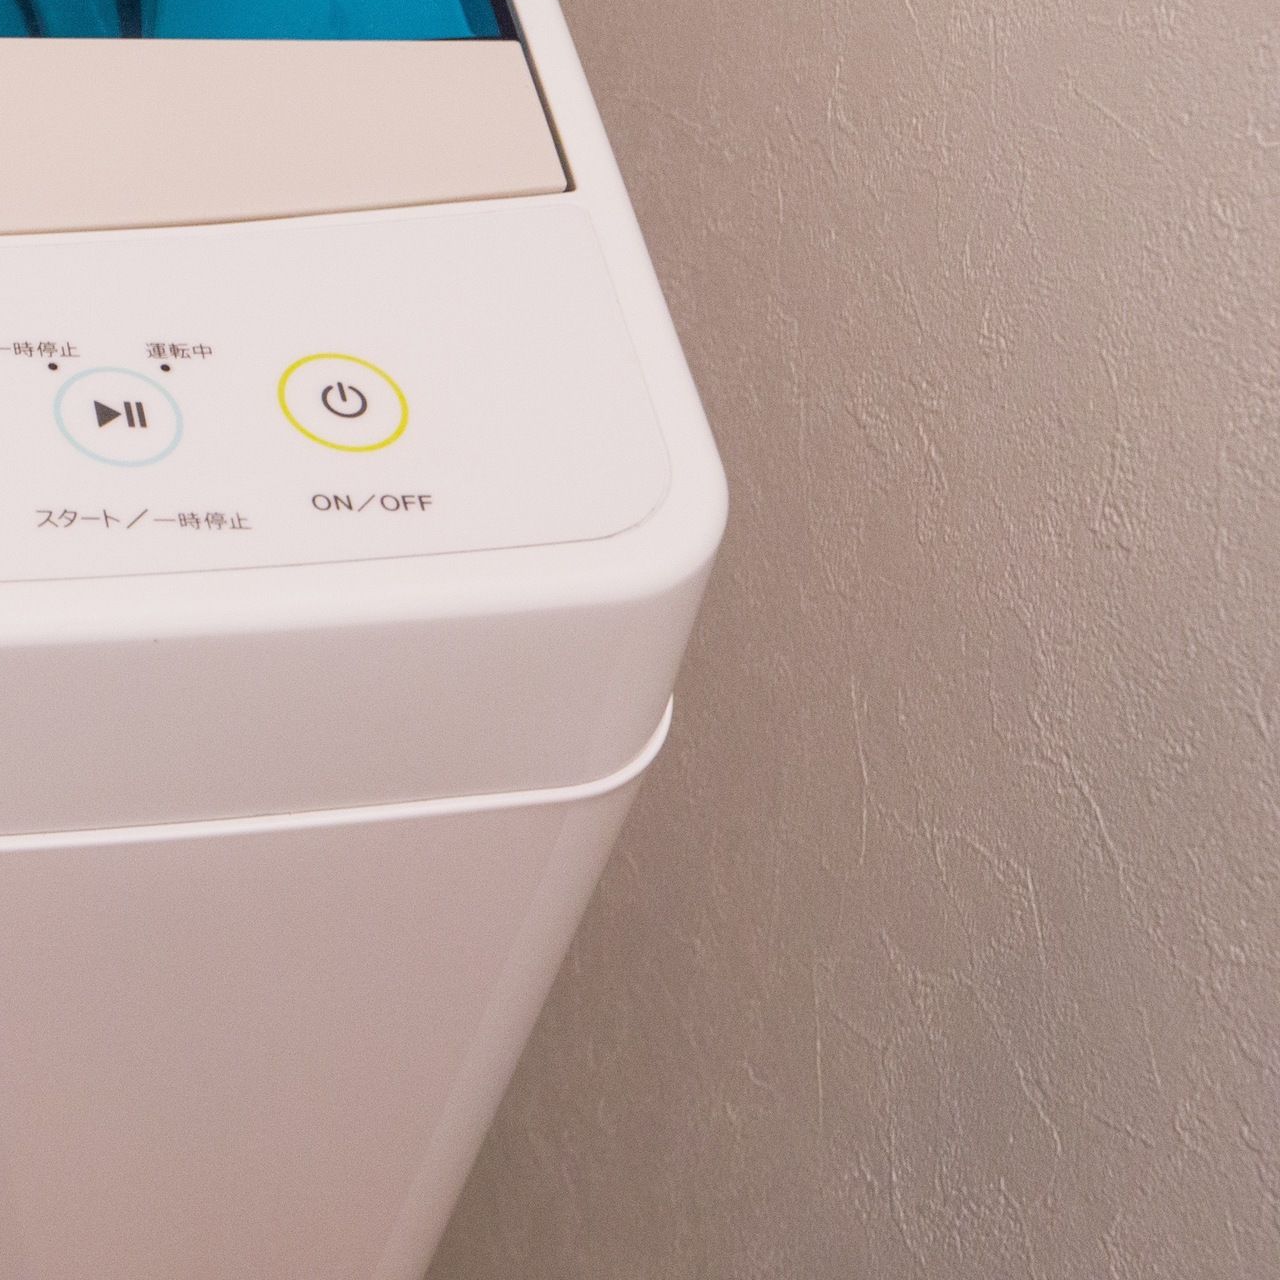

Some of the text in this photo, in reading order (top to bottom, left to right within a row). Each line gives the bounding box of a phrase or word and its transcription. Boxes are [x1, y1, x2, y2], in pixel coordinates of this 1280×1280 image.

[147, 342, 214, 360] 運転中
[311, 493, 434, 513] ON/OFF
